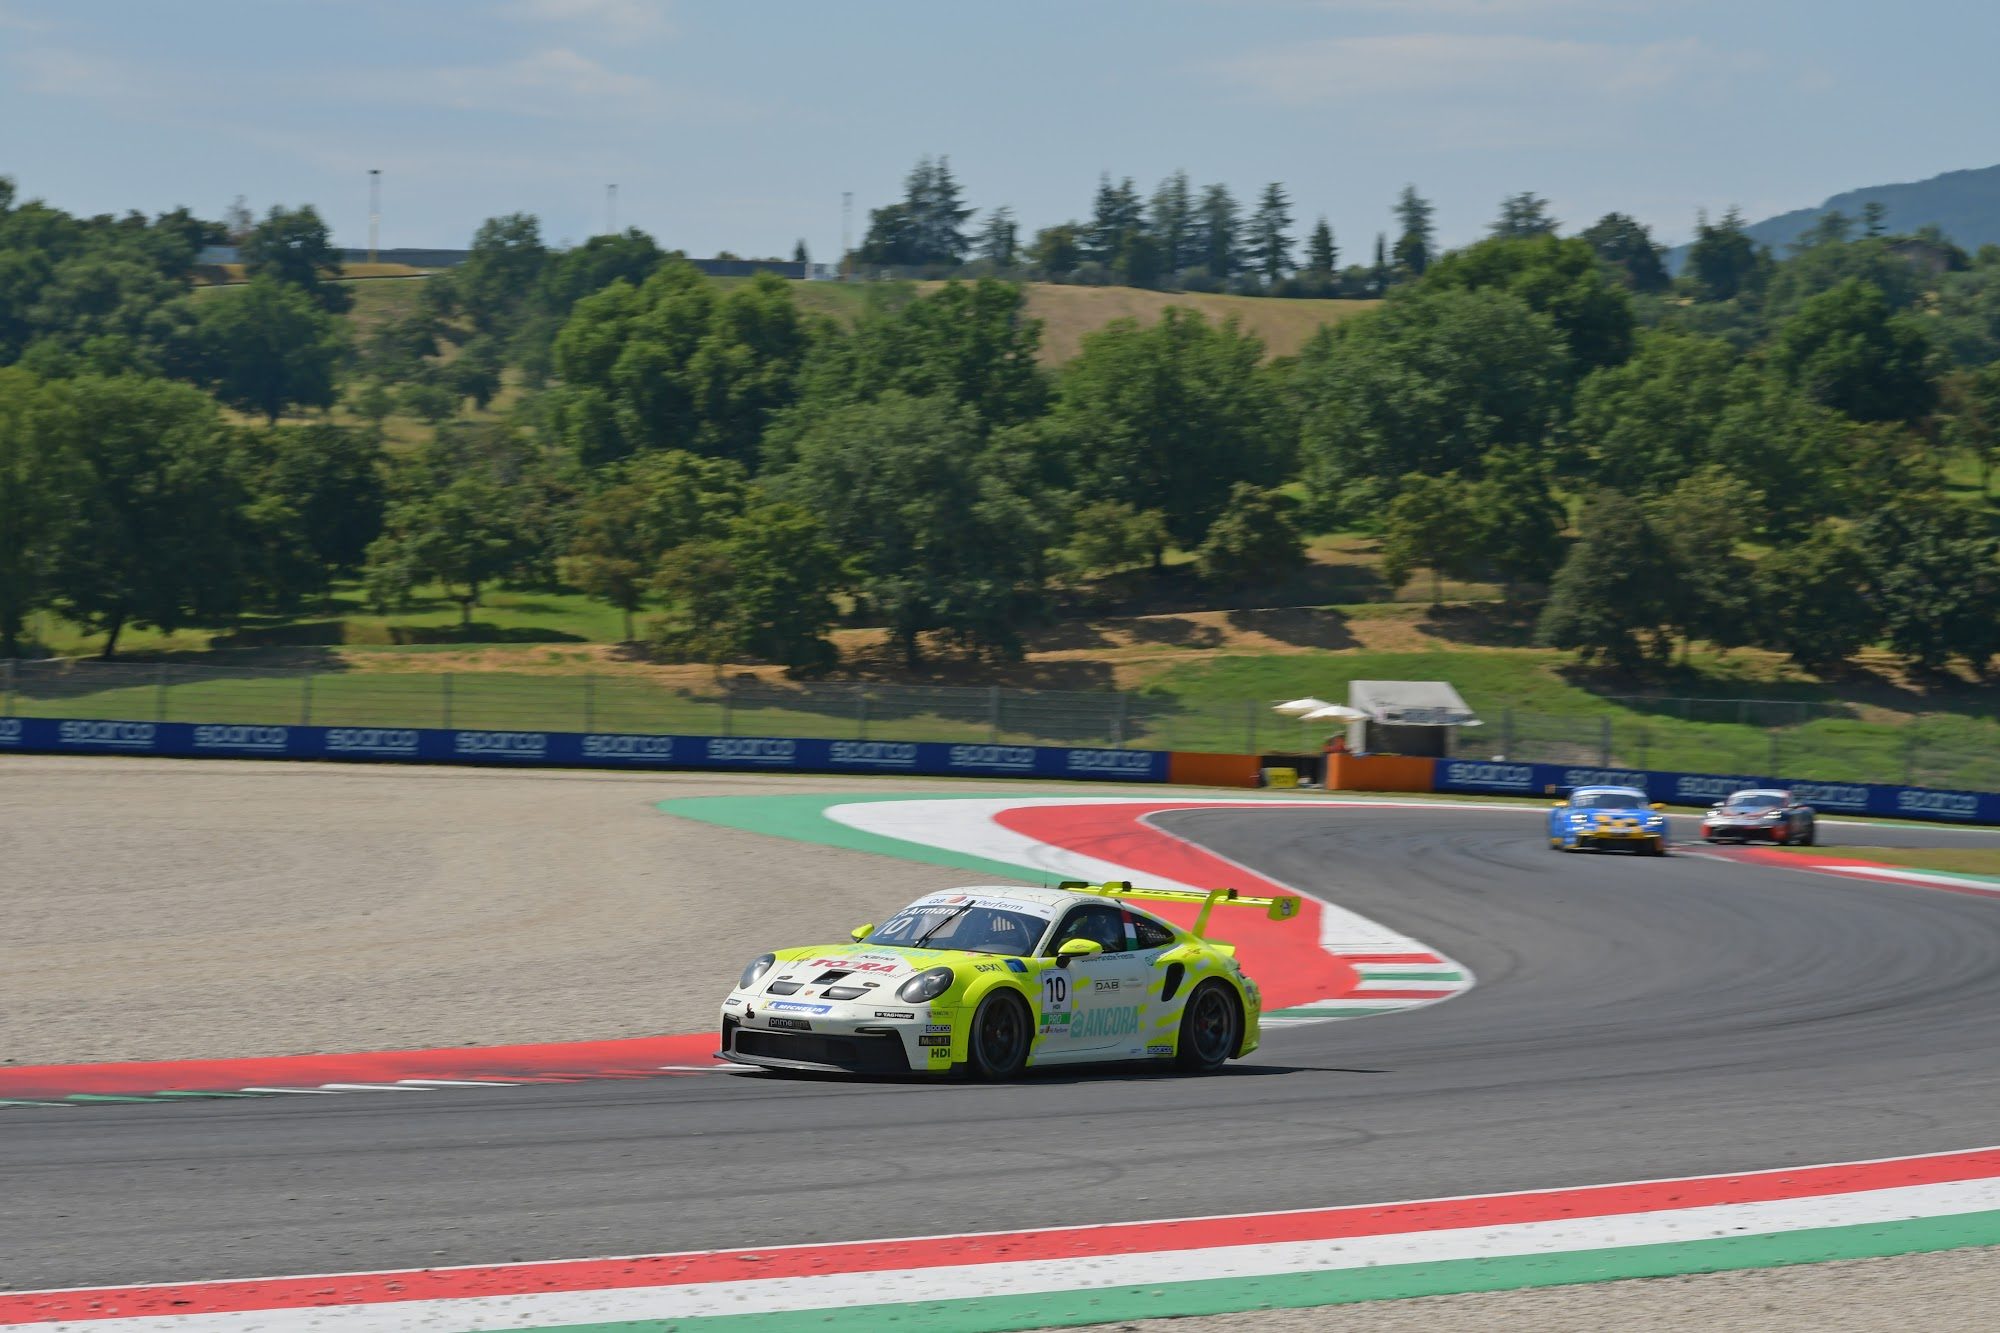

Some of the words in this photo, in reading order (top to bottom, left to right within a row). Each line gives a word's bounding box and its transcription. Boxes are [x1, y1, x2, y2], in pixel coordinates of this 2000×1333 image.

[59, 721, 155, 744] sparco
[193, 726, 287, 748] sparco
[325, 729, 418, 751] sparco
[455, 731, 547, 755] sparco
[582, 735, 673, 758] sparco
[707, 739, 796, 761] sparco
[829, 742, 917, 764] sparco
[950, 746, 1036, 768] sparco
[1066, 750, 1151, 772] sparco
[1447, 763, 1533, 786] sparco
[1900, 791, 1979, 813] sparco
[978, 900, 1023, 911] Perform
[874, 916, 914, 937] 10
[1046, 976, 1066, 1003] 10
[1095, 981, 1119, 991] DAB
[778, 1003, 826, 1013] MICHELIN
[926, 1025, 951, 1033] sparco
[1048, 1014, 1062, 1025] PRO
[1083, 1005, 1139, 1037] ANCORA
[931, 1048, 950, 1058] HDI
